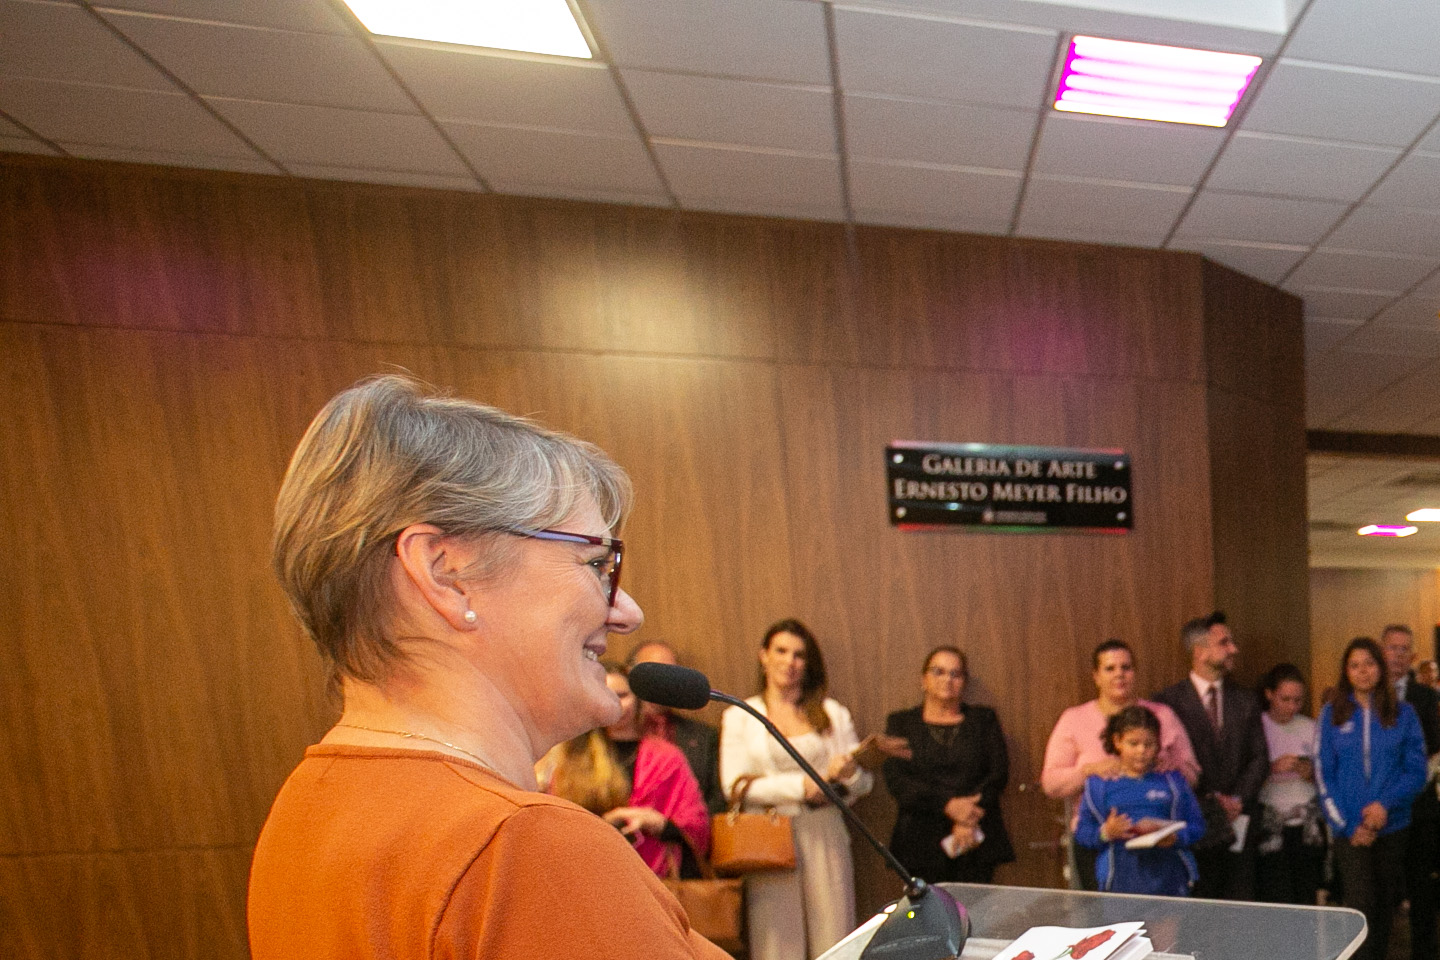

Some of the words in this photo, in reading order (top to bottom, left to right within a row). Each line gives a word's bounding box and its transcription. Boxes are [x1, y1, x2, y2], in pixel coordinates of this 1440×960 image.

[921, 454, 1011, 477] GALERIA
[1015, 459, 1043, 478] DE
[1046, 460, 1098, 479] ARTE
[894, 478, 988, 501] ERNESTO
[993, 482, 1062, 502] MEYER
[1066, 483, 1128, 504] FILHO
